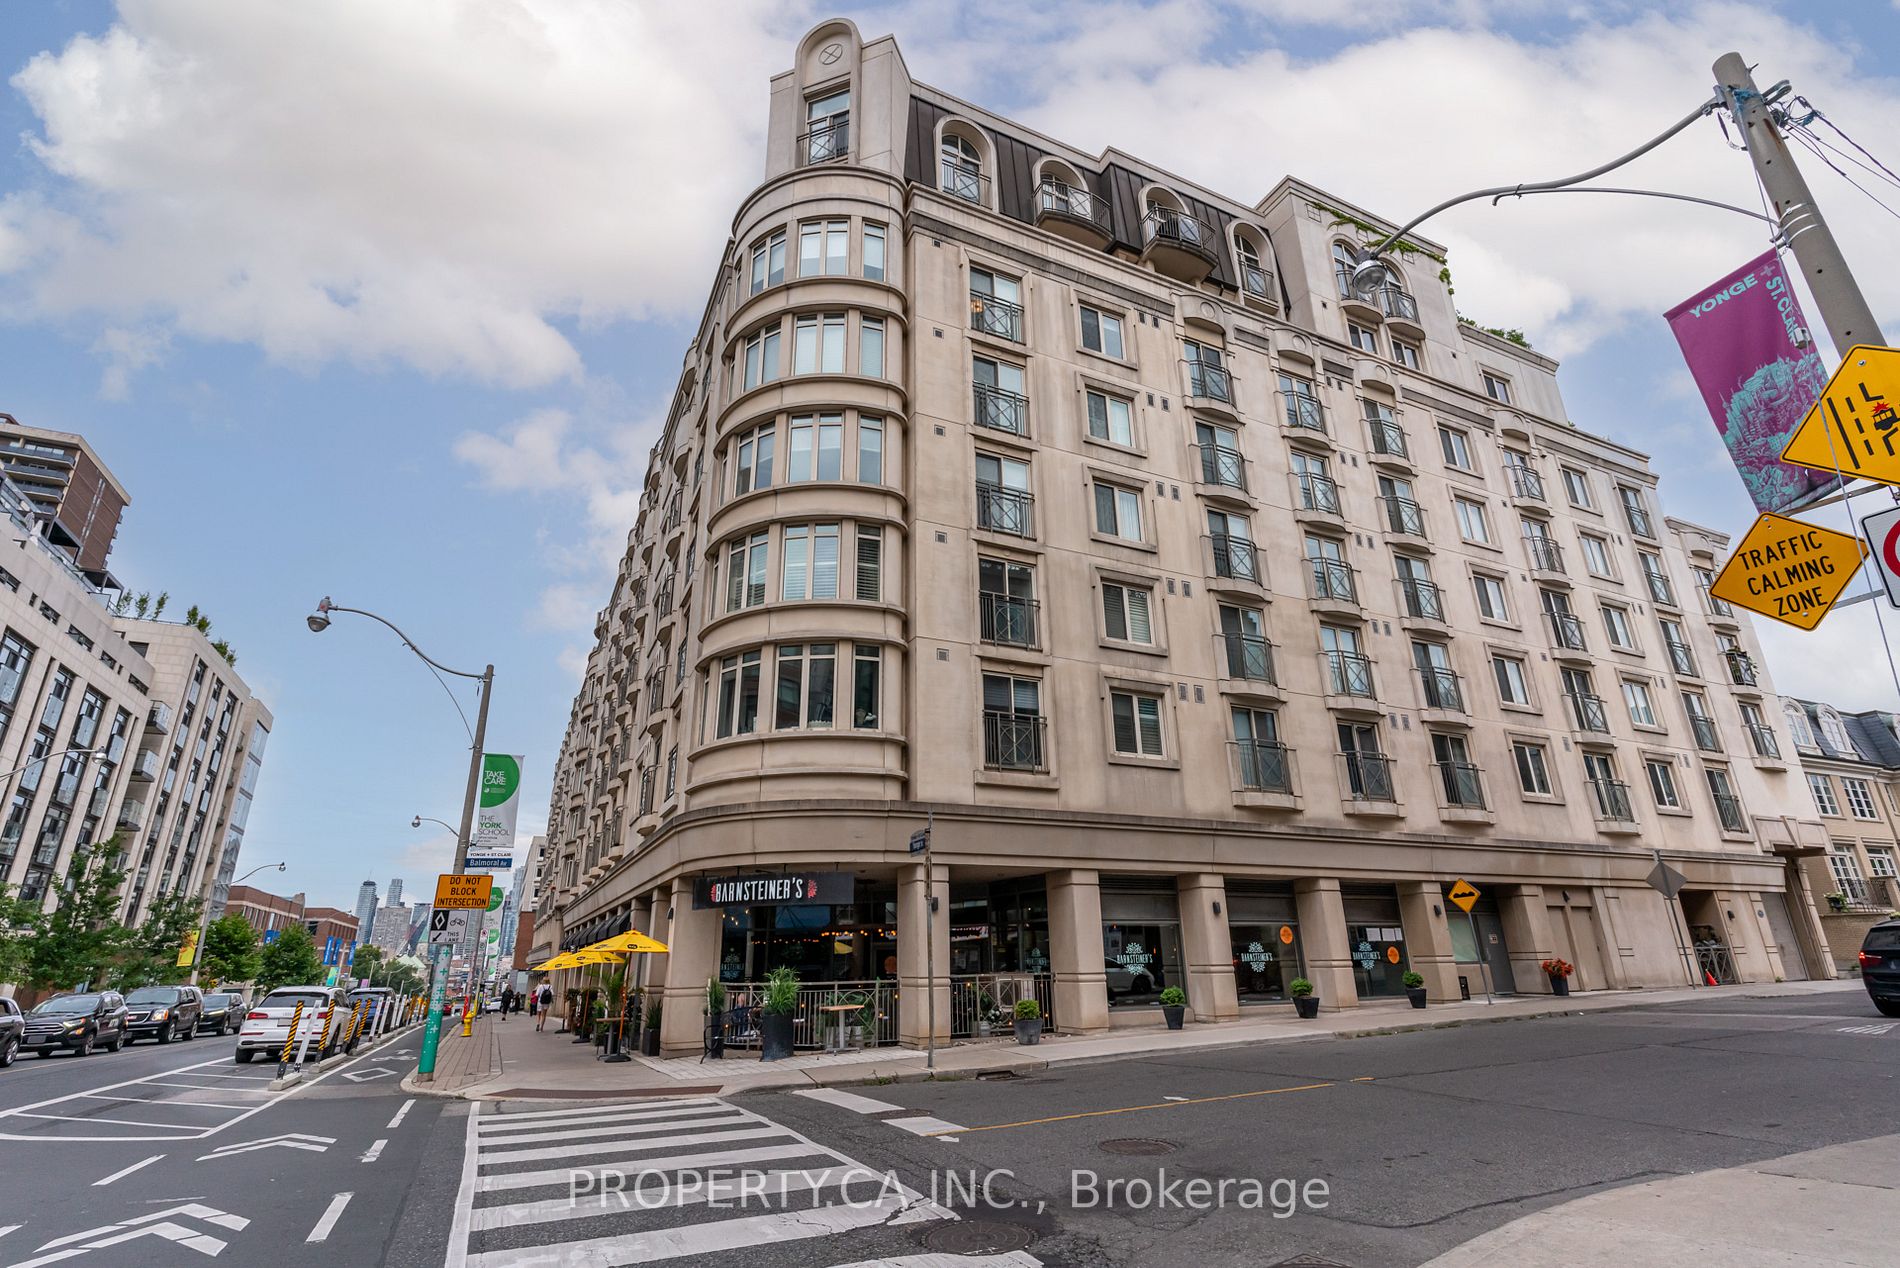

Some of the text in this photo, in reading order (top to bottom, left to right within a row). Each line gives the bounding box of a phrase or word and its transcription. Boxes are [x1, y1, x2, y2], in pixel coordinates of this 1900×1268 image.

[1689, 273, 1758, 318] YONGE
[1766, 276, 1786, 300] ST.
[1738, 530, 1823, 571] TRAFFIC
[1747, 555, 1835, 596] CALMING
[1773, 586, 1828, 617] ZONE
[484, 770, 505, 778] TAKE
[483, 777, 506, 785] CARE
[470, 859, 500, 867] Balmoral
[450, 876, 481, 885] DO NOT
[450, 887, 477, 896] BLOCK
[716, 877, 804, 903] BARNSTEINER'S
[437, 897, 487, 907] INTERSECTION
